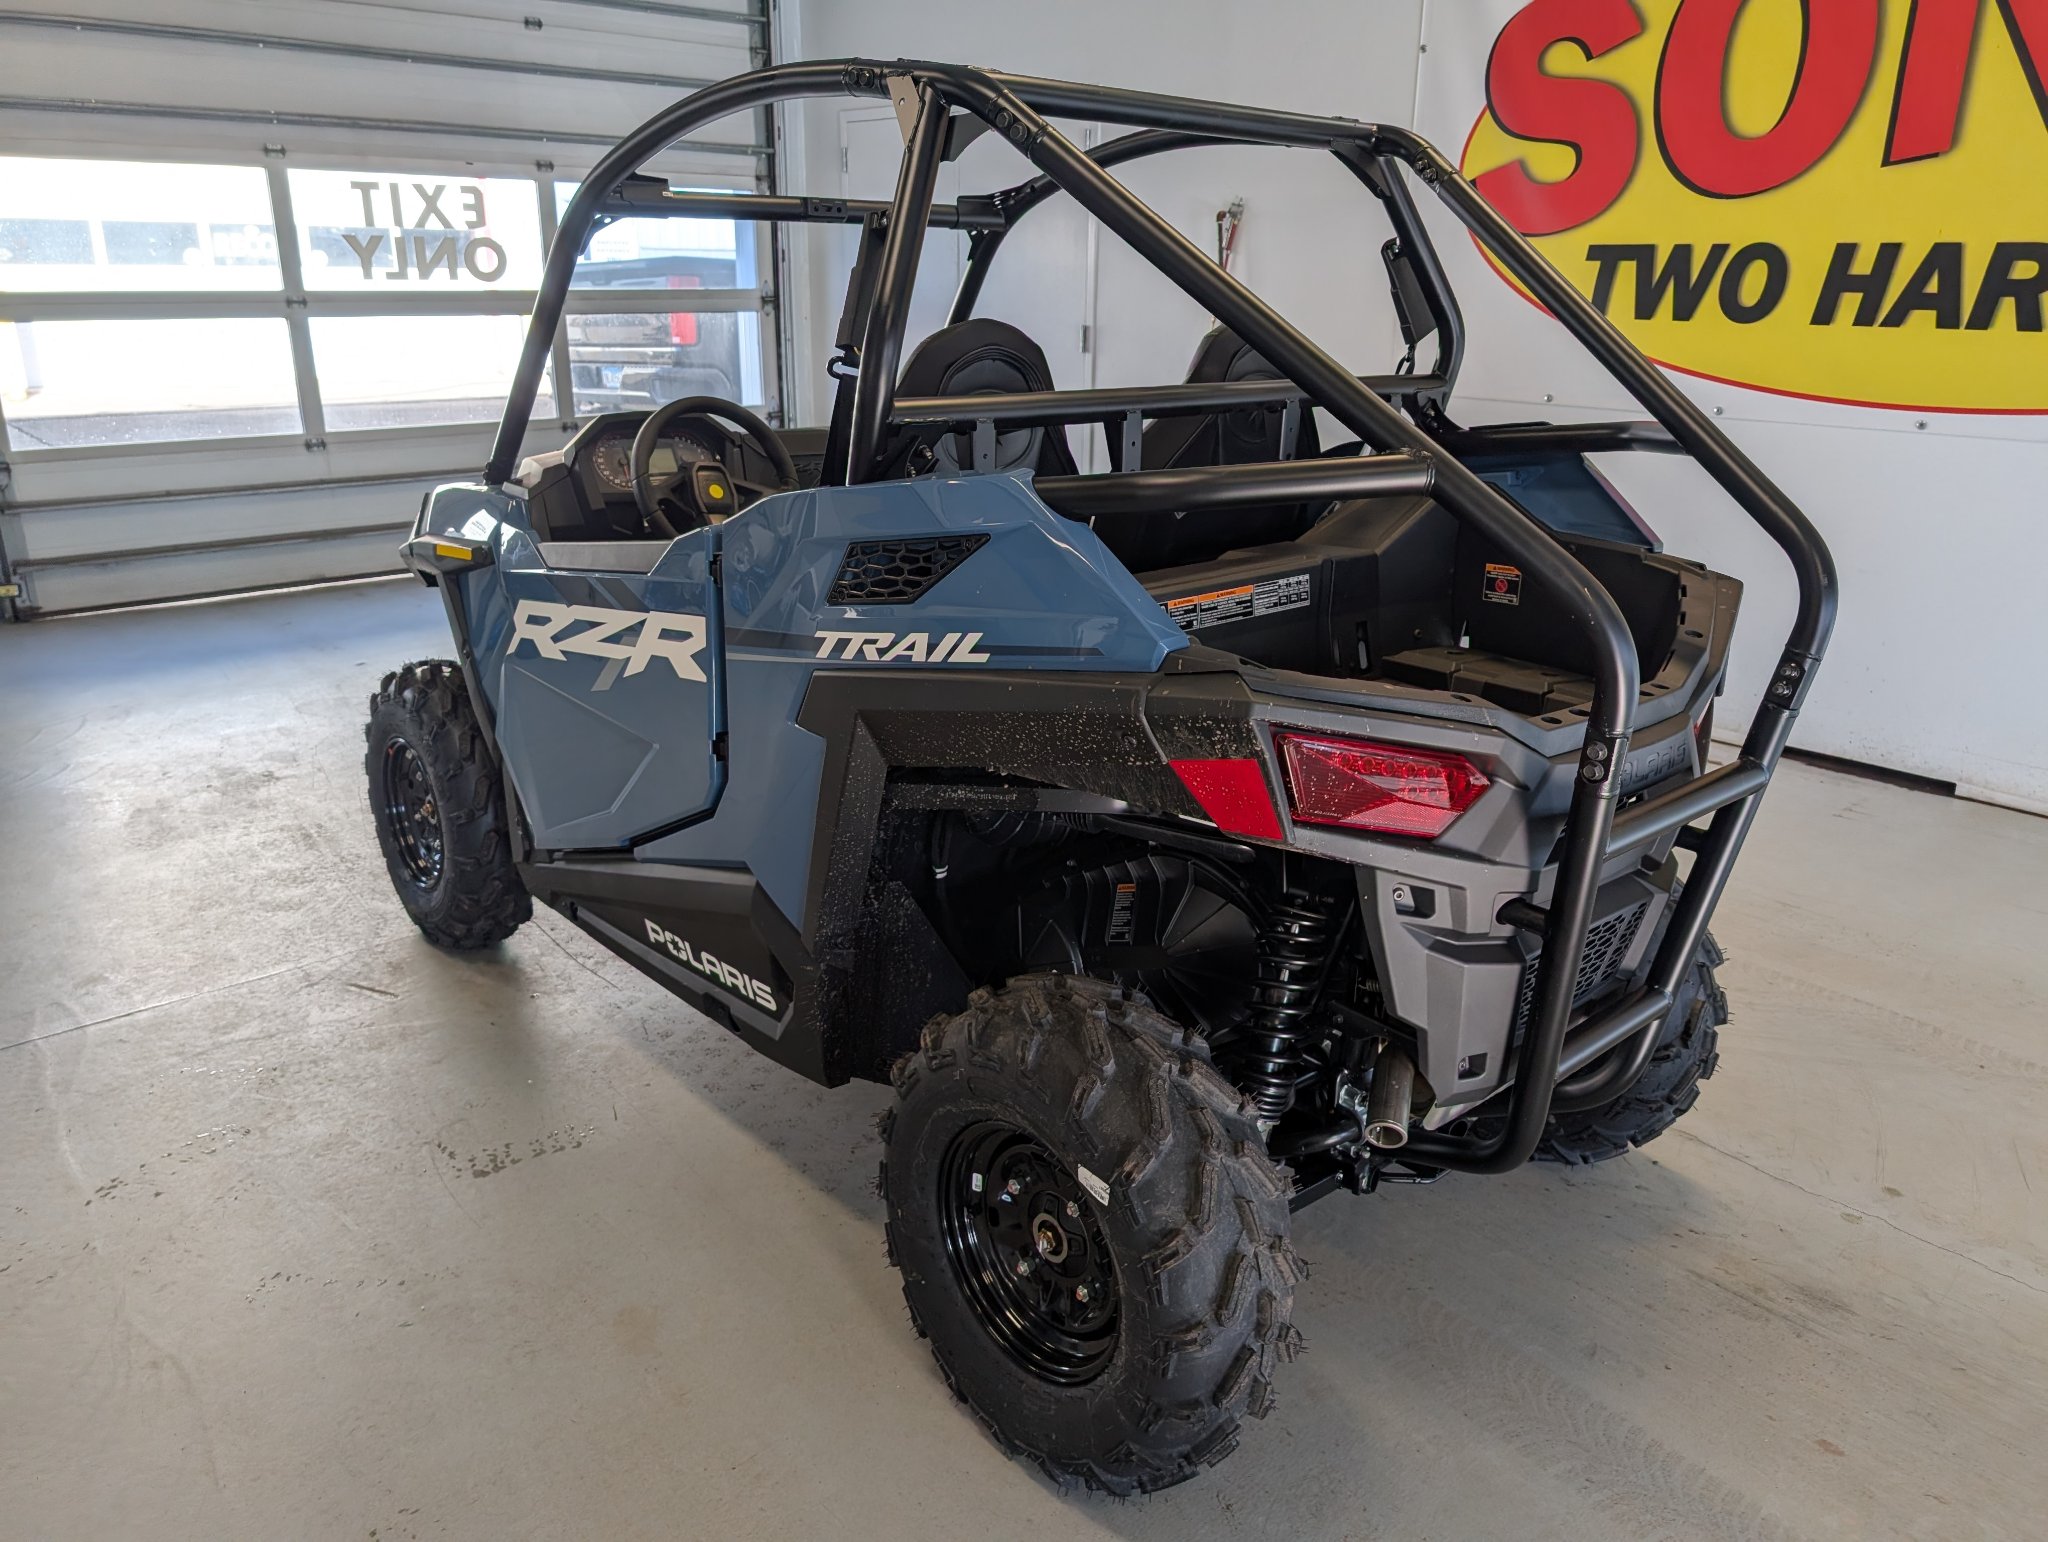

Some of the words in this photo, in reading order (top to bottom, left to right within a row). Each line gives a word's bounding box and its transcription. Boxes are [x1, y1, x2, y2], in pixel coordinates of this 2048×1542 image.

[1585, 242, 1788, 324] TWO
[1809, 242, 2048, 332] HAR
[506, 599, 708, 683] RZR
[814, 630, 991, 663] TRAIL
[1621, 742, 1687, 787] OLARIS
[644, 918, 777, 1011] POLARIS
